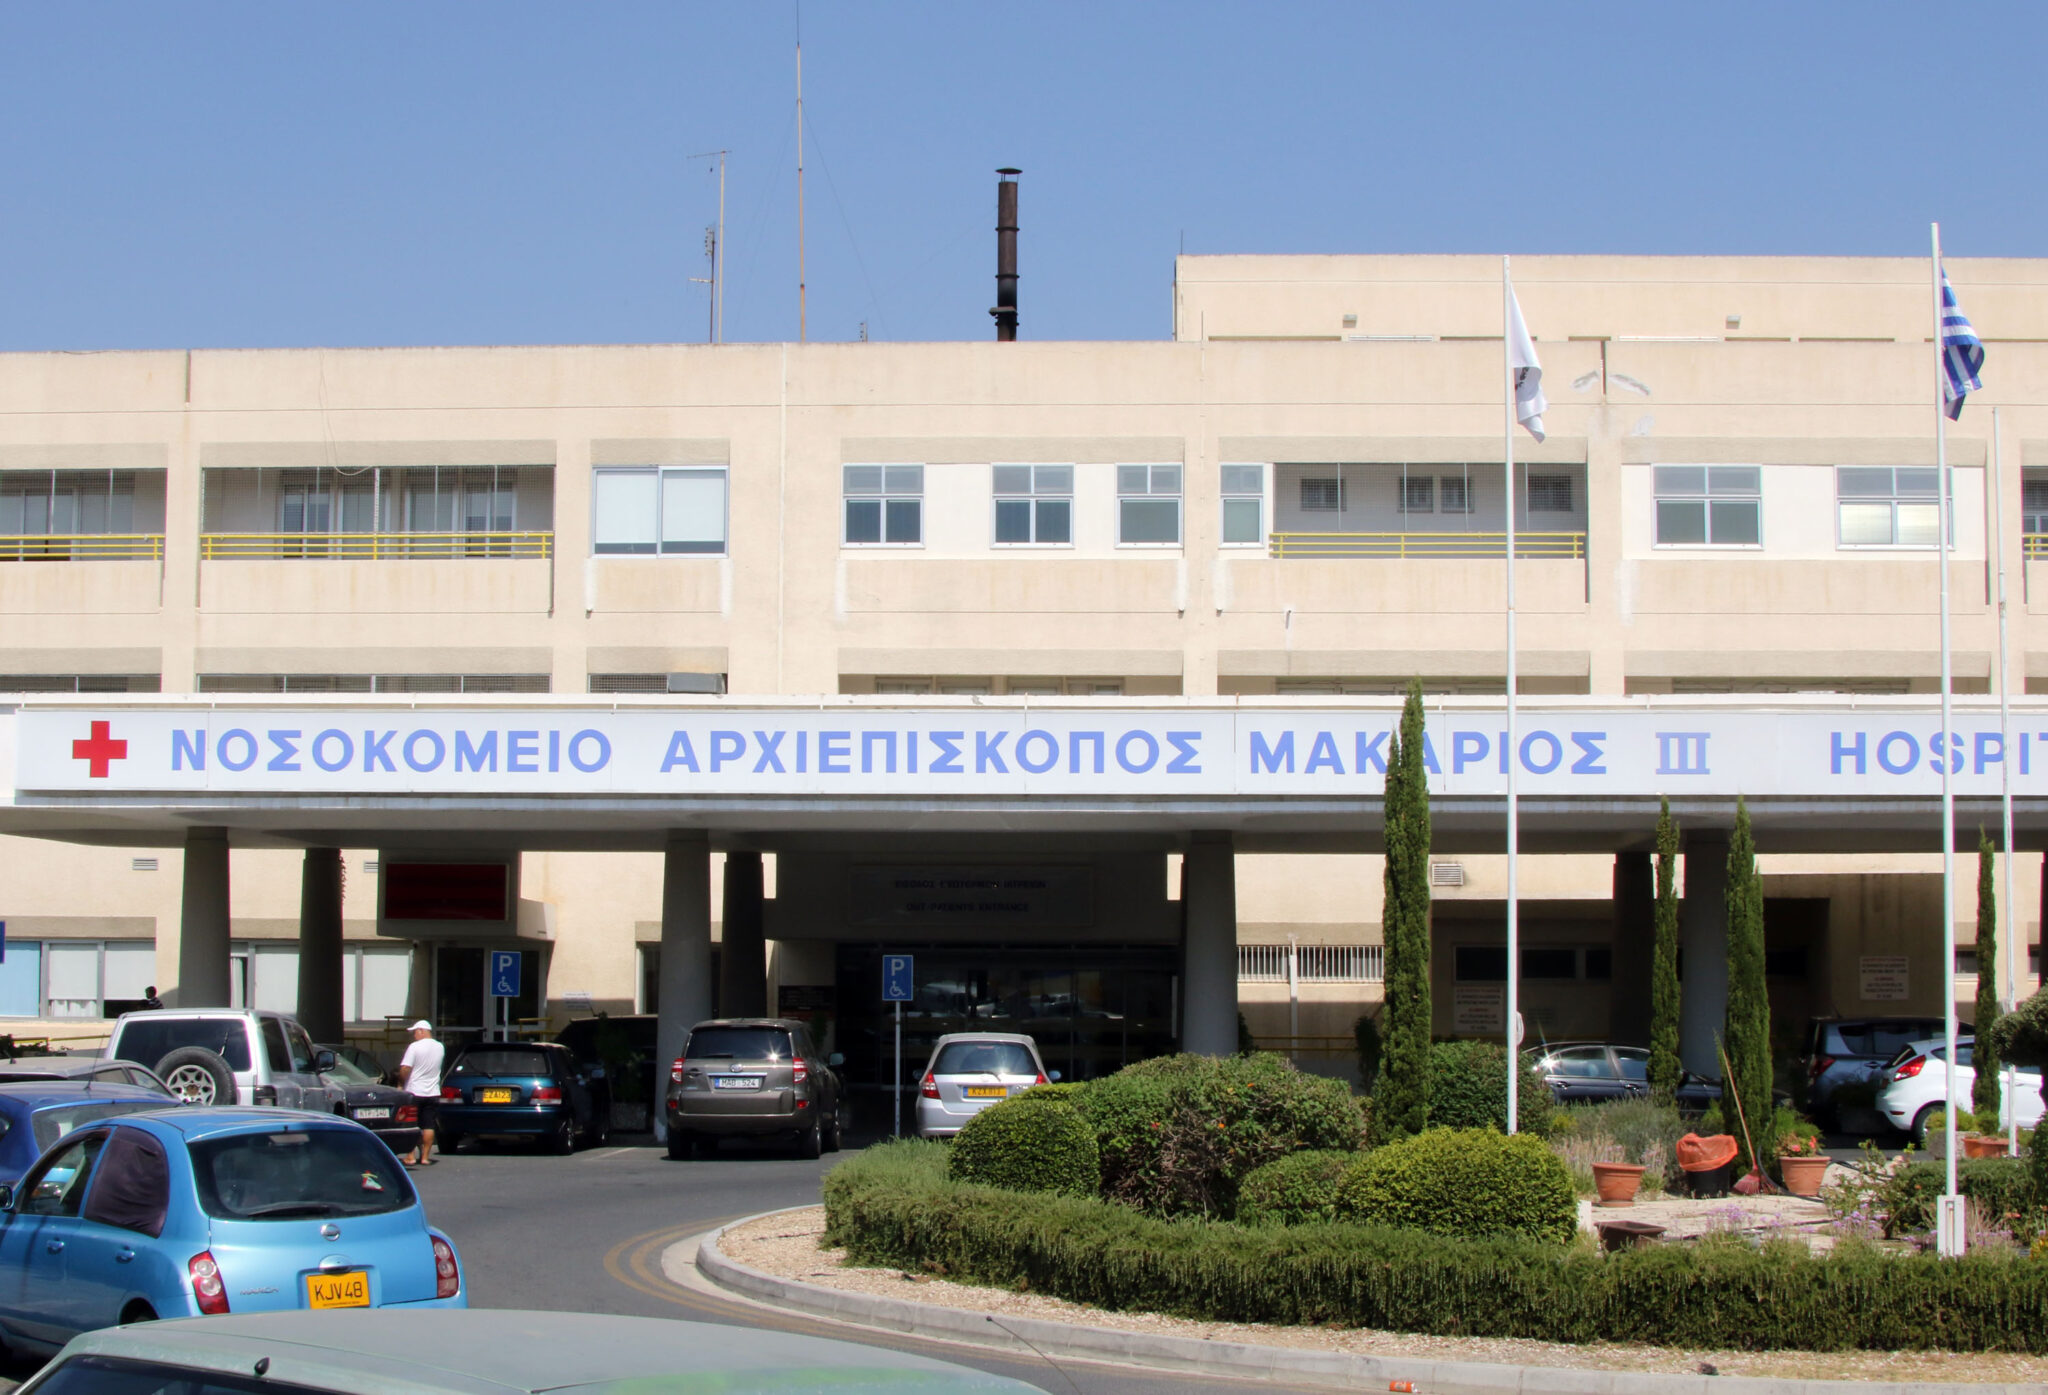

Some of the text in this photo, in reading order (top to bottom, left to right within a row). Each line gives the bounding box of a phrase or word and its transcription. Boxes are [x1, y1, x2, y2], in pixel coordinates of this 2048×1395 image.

[171, 728, 612, 773] ΝΟΣΟΚΟΜΕΙΟ
[660, 729, 1202, 774] ΑΡΧΙΕΠΙΣΚΟΠΟΣ
[1655, 732, 1710, 774] III
[1831, 731, 2048, 775] HOSPI
[499, 955, 512, 973] P
[891, 959, 905, 976] P
